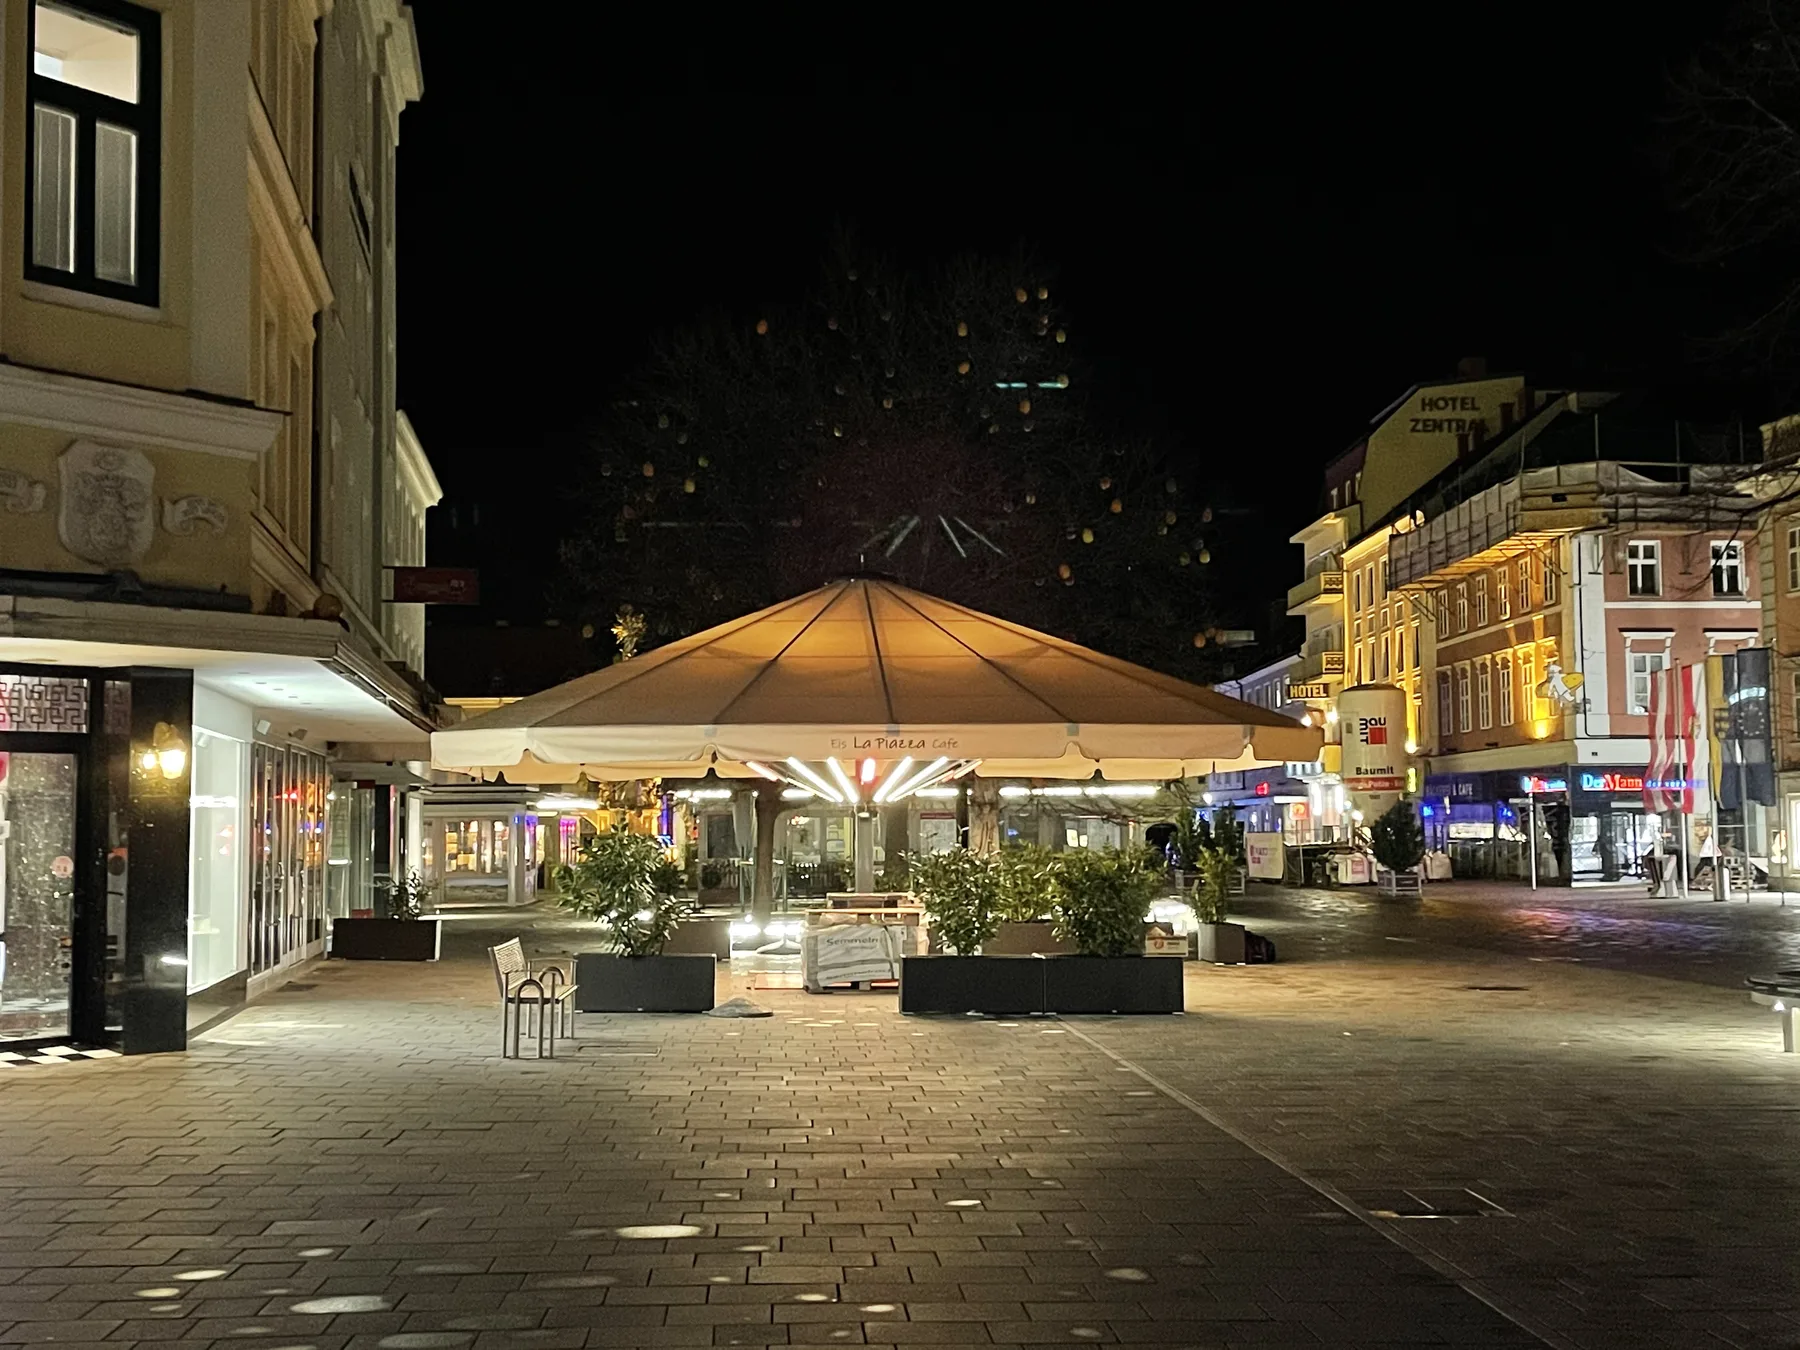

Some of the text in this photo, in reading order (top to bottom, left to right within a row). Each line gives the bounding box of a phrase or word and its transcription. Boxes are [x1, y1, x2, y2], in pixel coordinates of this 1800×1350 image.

[1421, 397, 1480, 411] HOTEL
[1290, 685, 1327, 697] HOTEL
[831, 736, 959, 749] Eis La Piazza Cafe
[1356, 766, 1394, 775] Baumit
